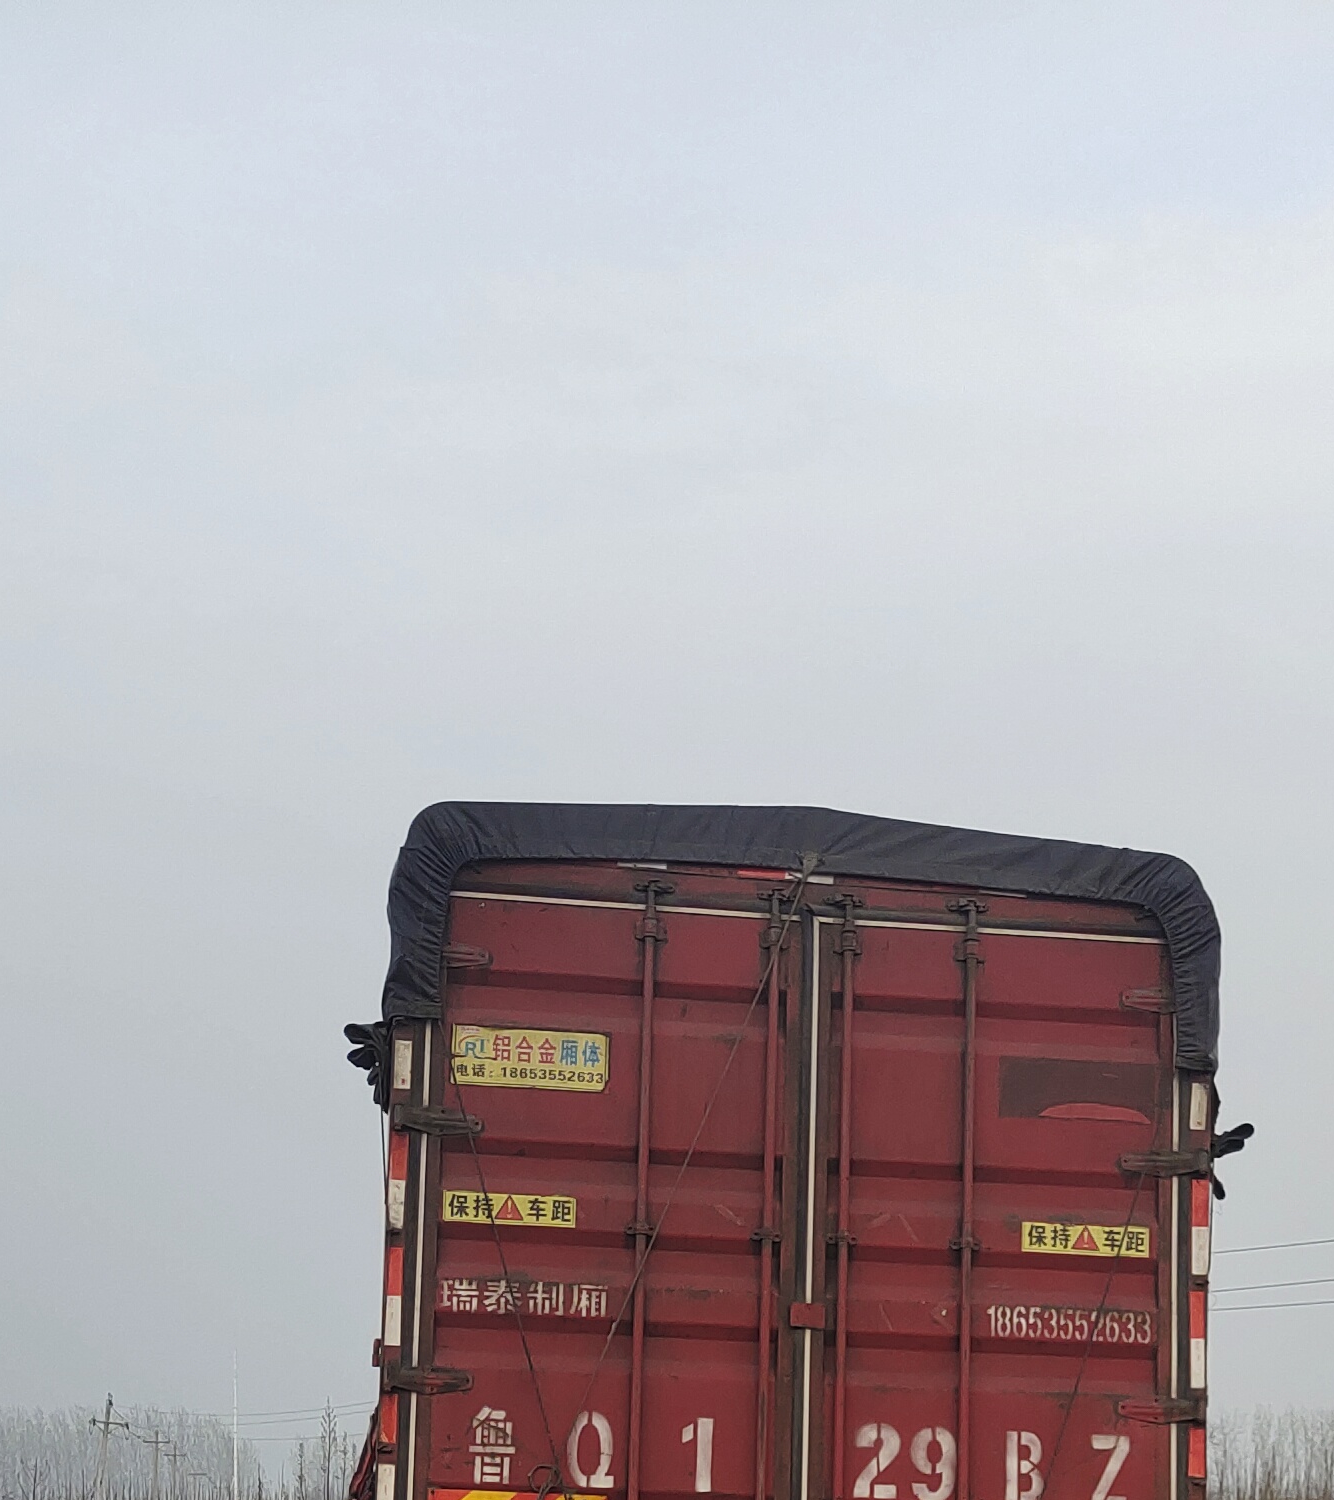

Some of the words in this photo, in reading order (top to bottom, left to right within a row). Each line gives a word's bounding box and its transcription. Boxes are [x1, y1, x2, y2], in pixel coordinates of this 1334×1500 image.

[492, 1034, 602, 1067] 铝合金厢体
[441, 1278, 608, 1318] 瑞泰制厢
[987, 1305, 1152, 1344] 18653552633
